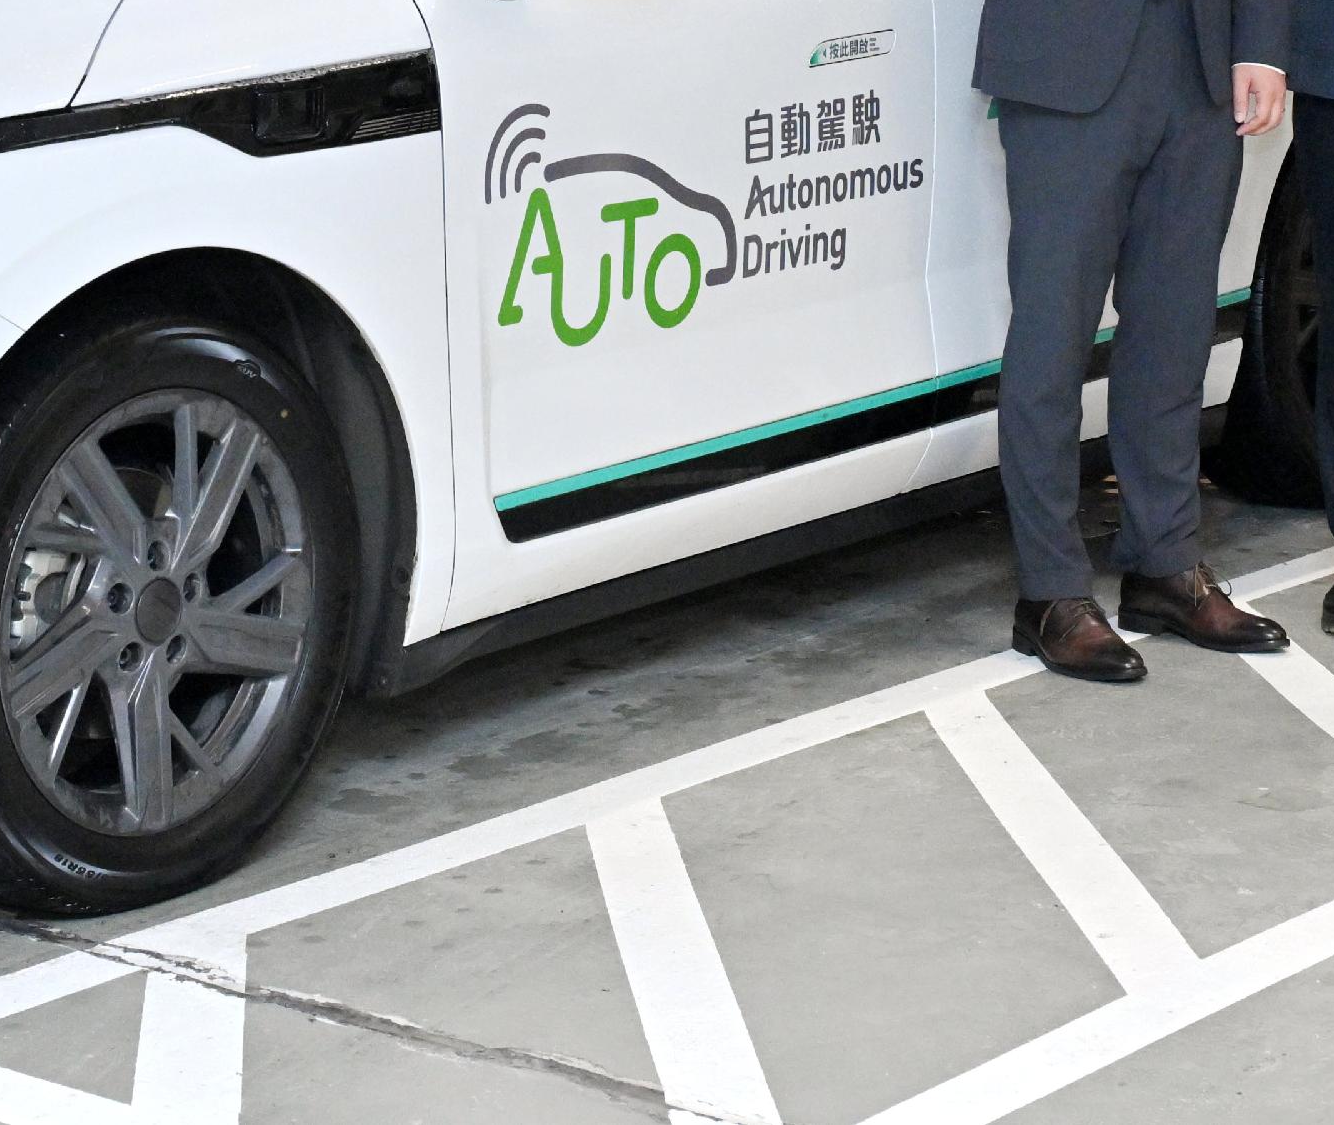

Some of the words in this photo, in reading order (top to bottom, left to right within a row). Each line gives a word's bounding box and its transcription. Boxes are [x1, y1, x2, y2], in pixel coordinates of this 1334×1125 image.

[744, 89, 881, 165] 自動駕駛
[743, 157, 924, 220] Autonomous
[742, 224, 848, 279] Driving
